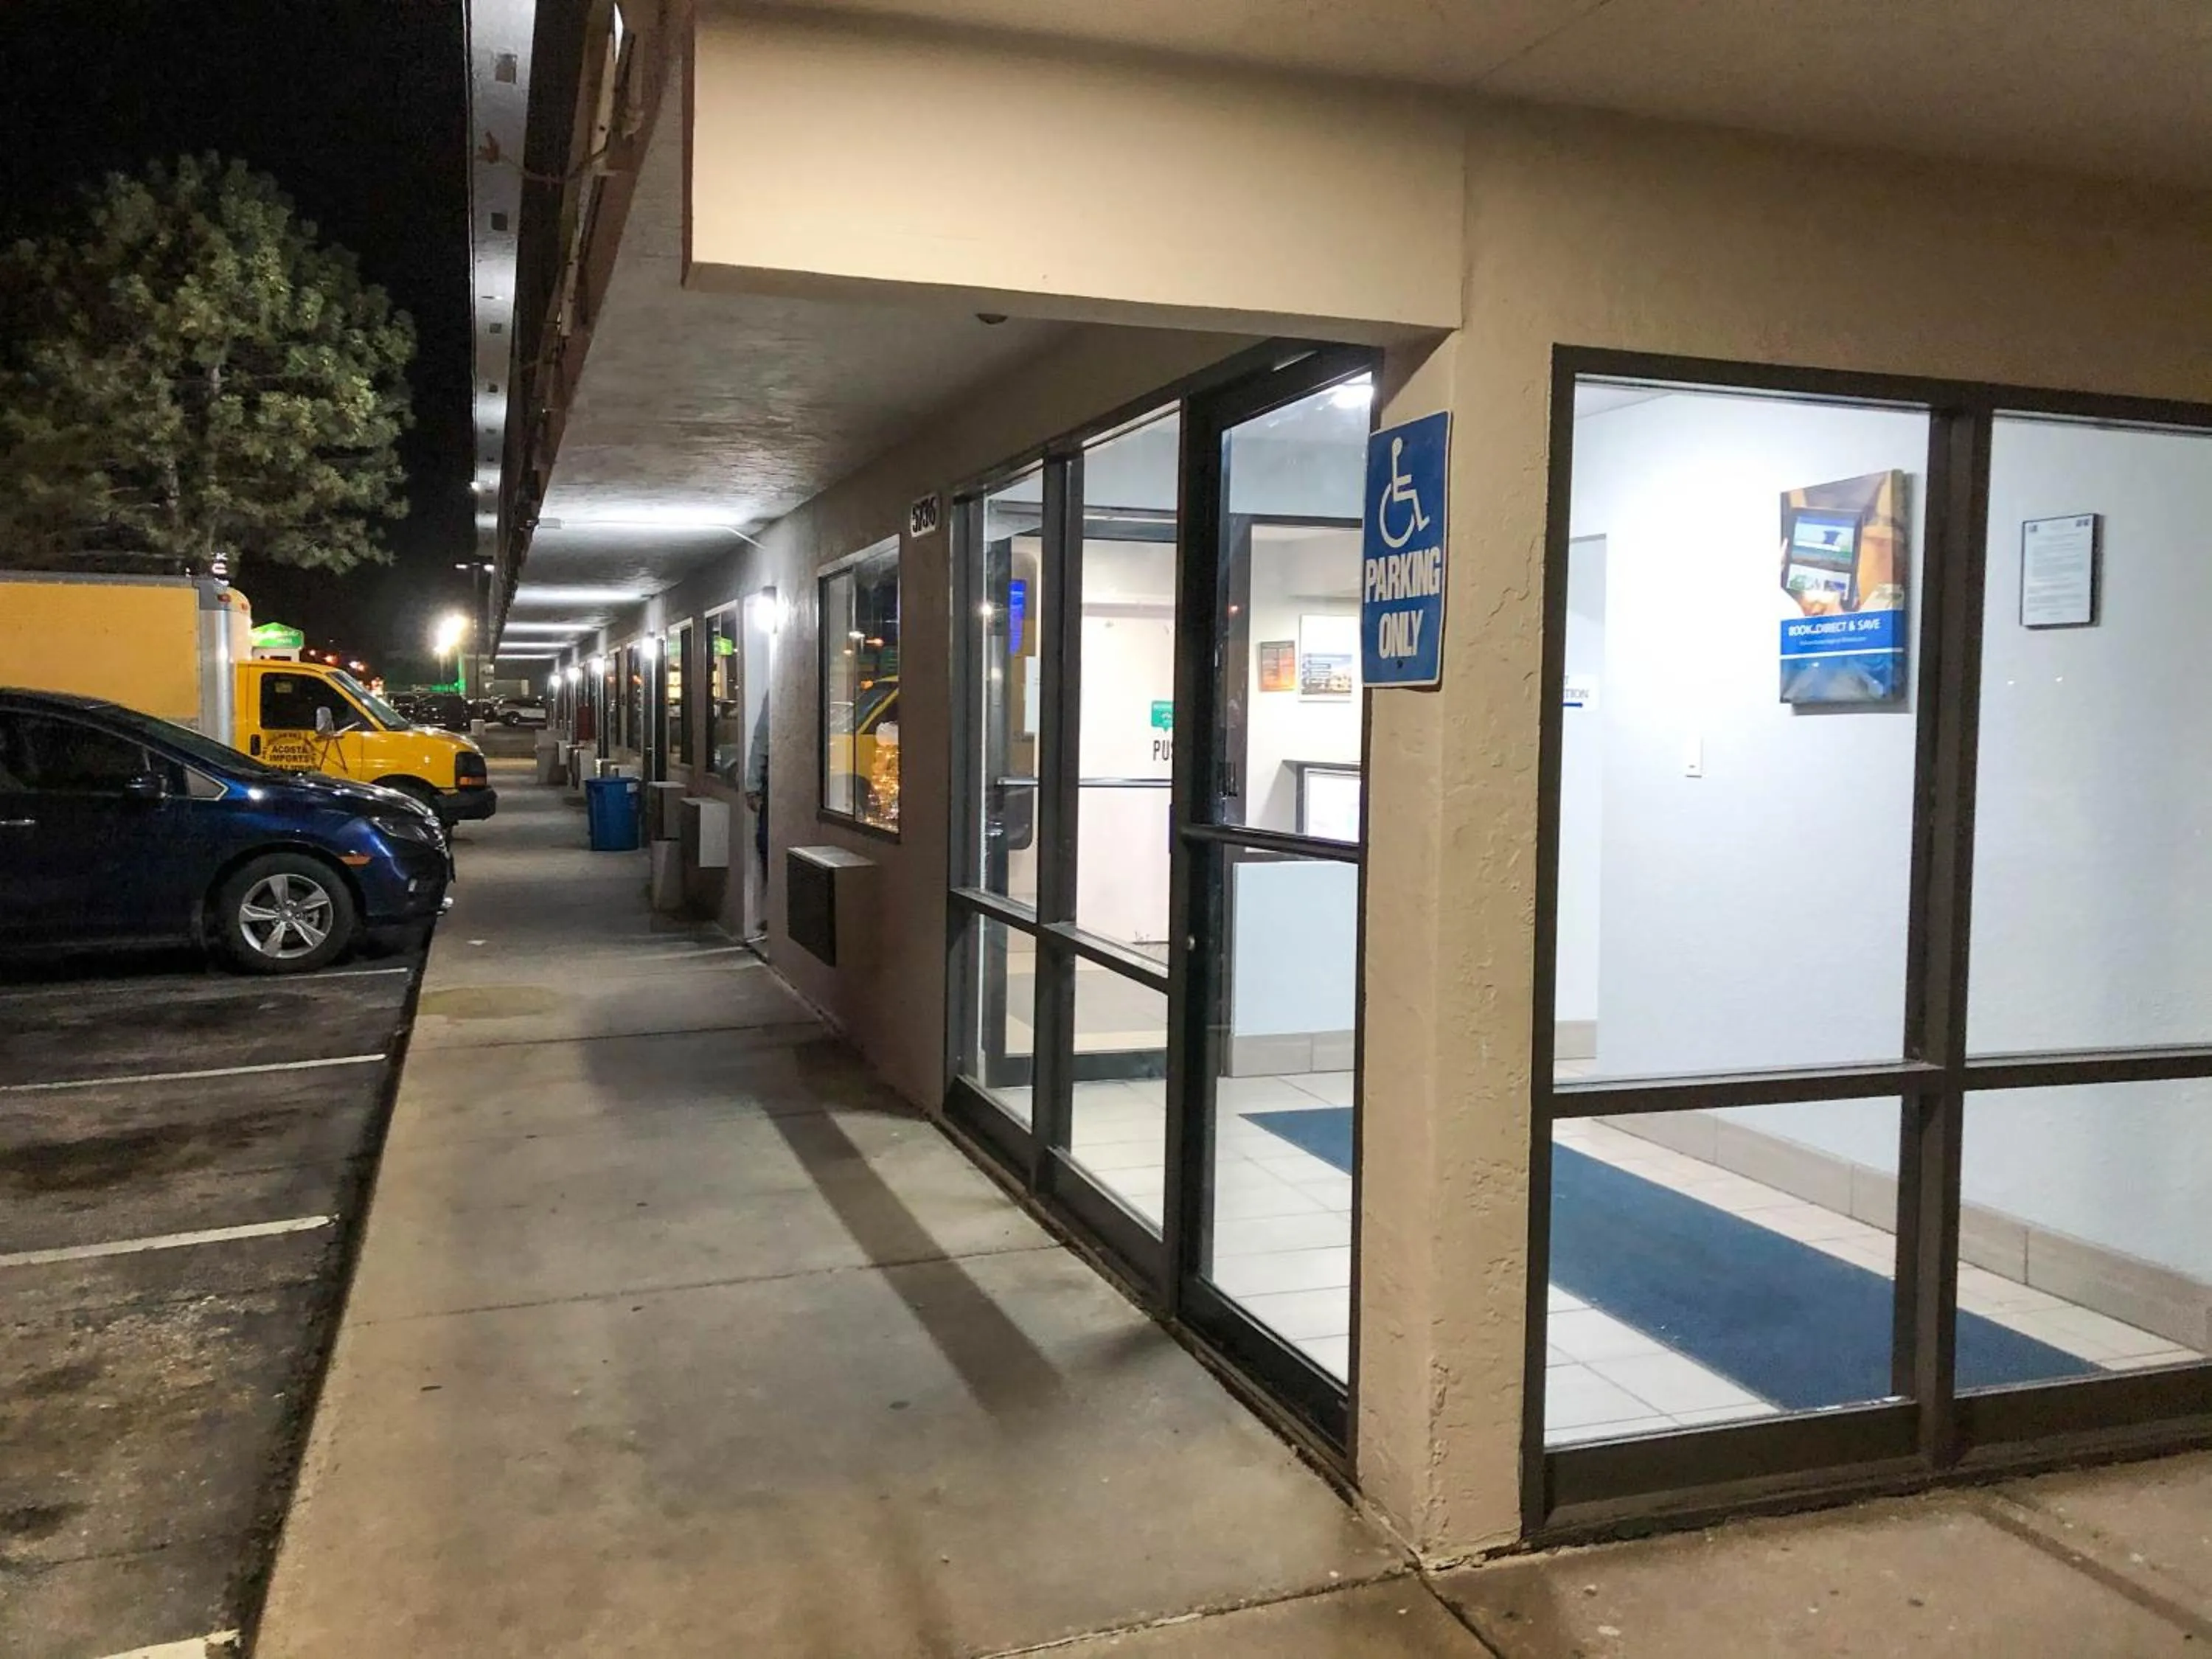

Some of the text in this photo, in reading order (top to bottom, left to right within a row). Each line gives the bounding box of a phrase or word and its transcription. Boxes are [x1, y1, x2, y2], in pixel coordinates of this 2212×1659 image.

[1365, 546, 1440, 603] PARKING
[1378, 609, 1424, 658] ONLY
[1788, 625, 1812, 636] BOOK
[1815, 622, 1846, 633] DIRECT
[1858, 619, 1881, 630] SAVE
[1152, 740, 1172, 761] PU
